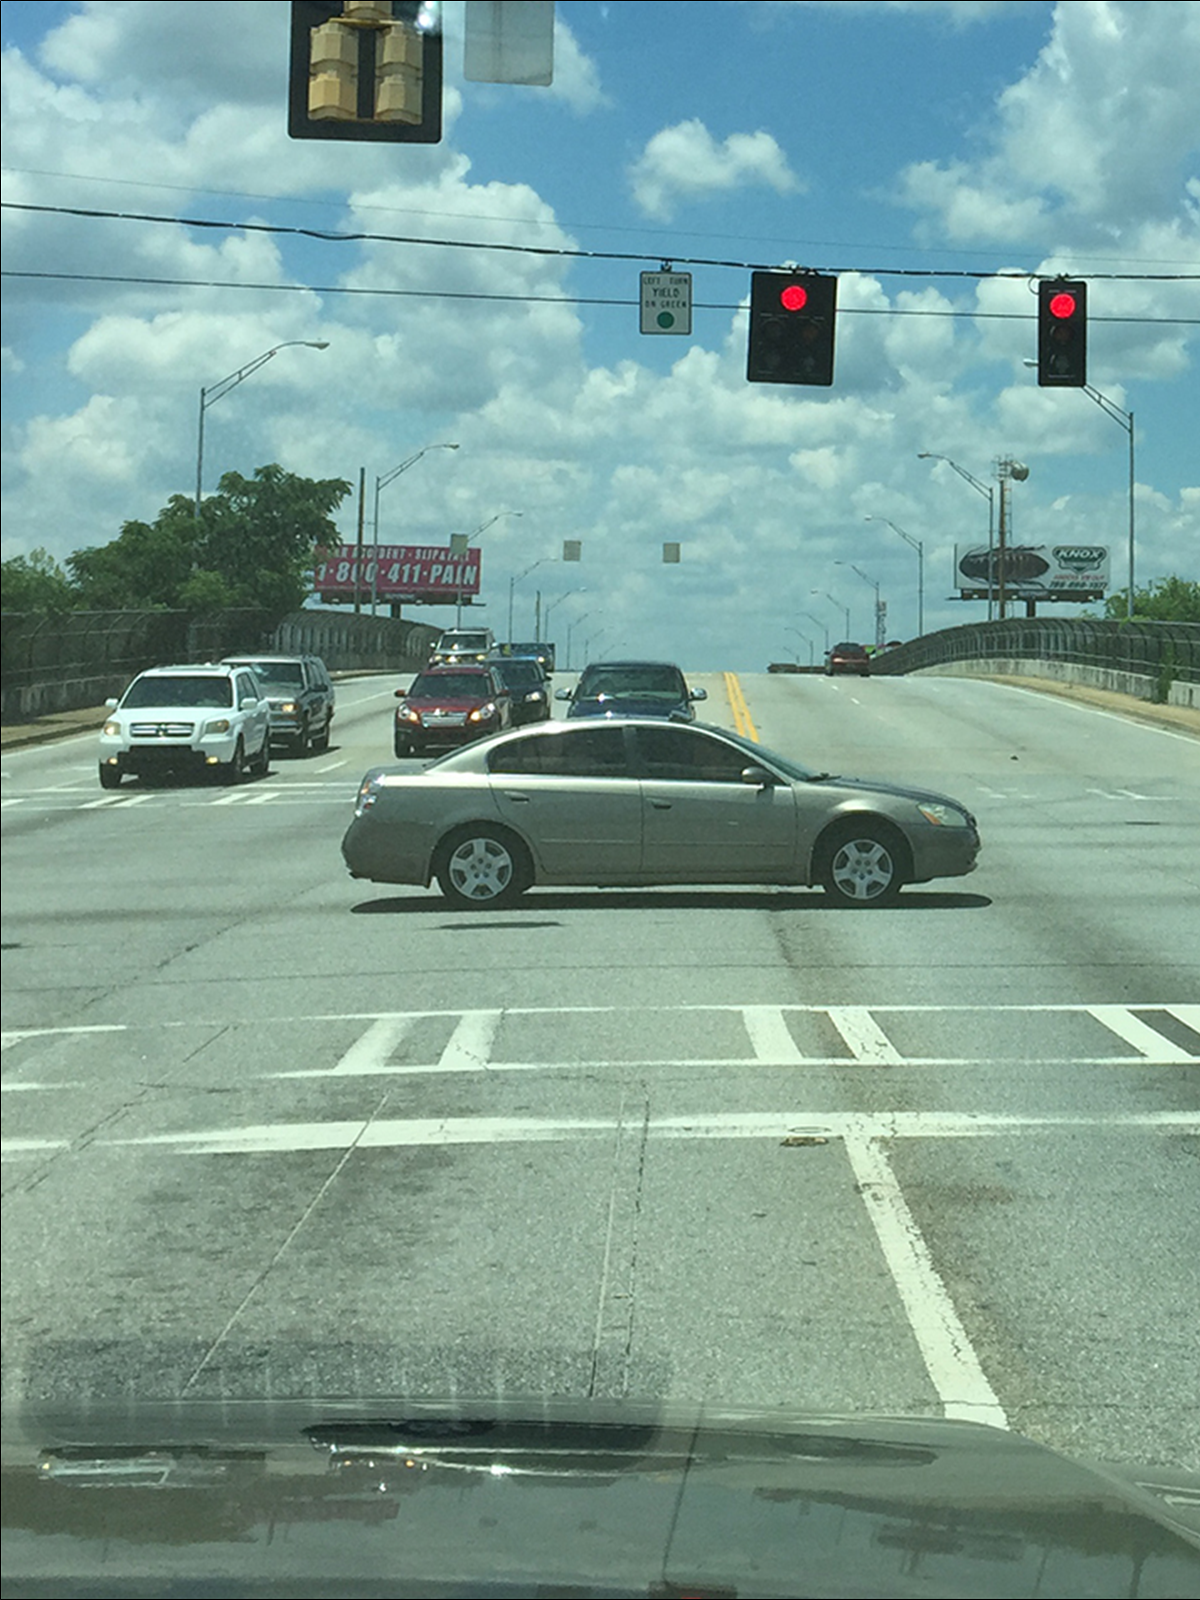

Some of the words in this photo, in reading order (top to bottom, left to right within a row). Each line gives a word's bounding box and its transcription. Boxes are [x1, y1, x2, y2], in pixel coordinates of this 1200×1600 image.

[652, 287, 680, 298] YIELD
[660, 300, 687, 309] GREEN
[1058, 549, 1101, 559] KNOX
